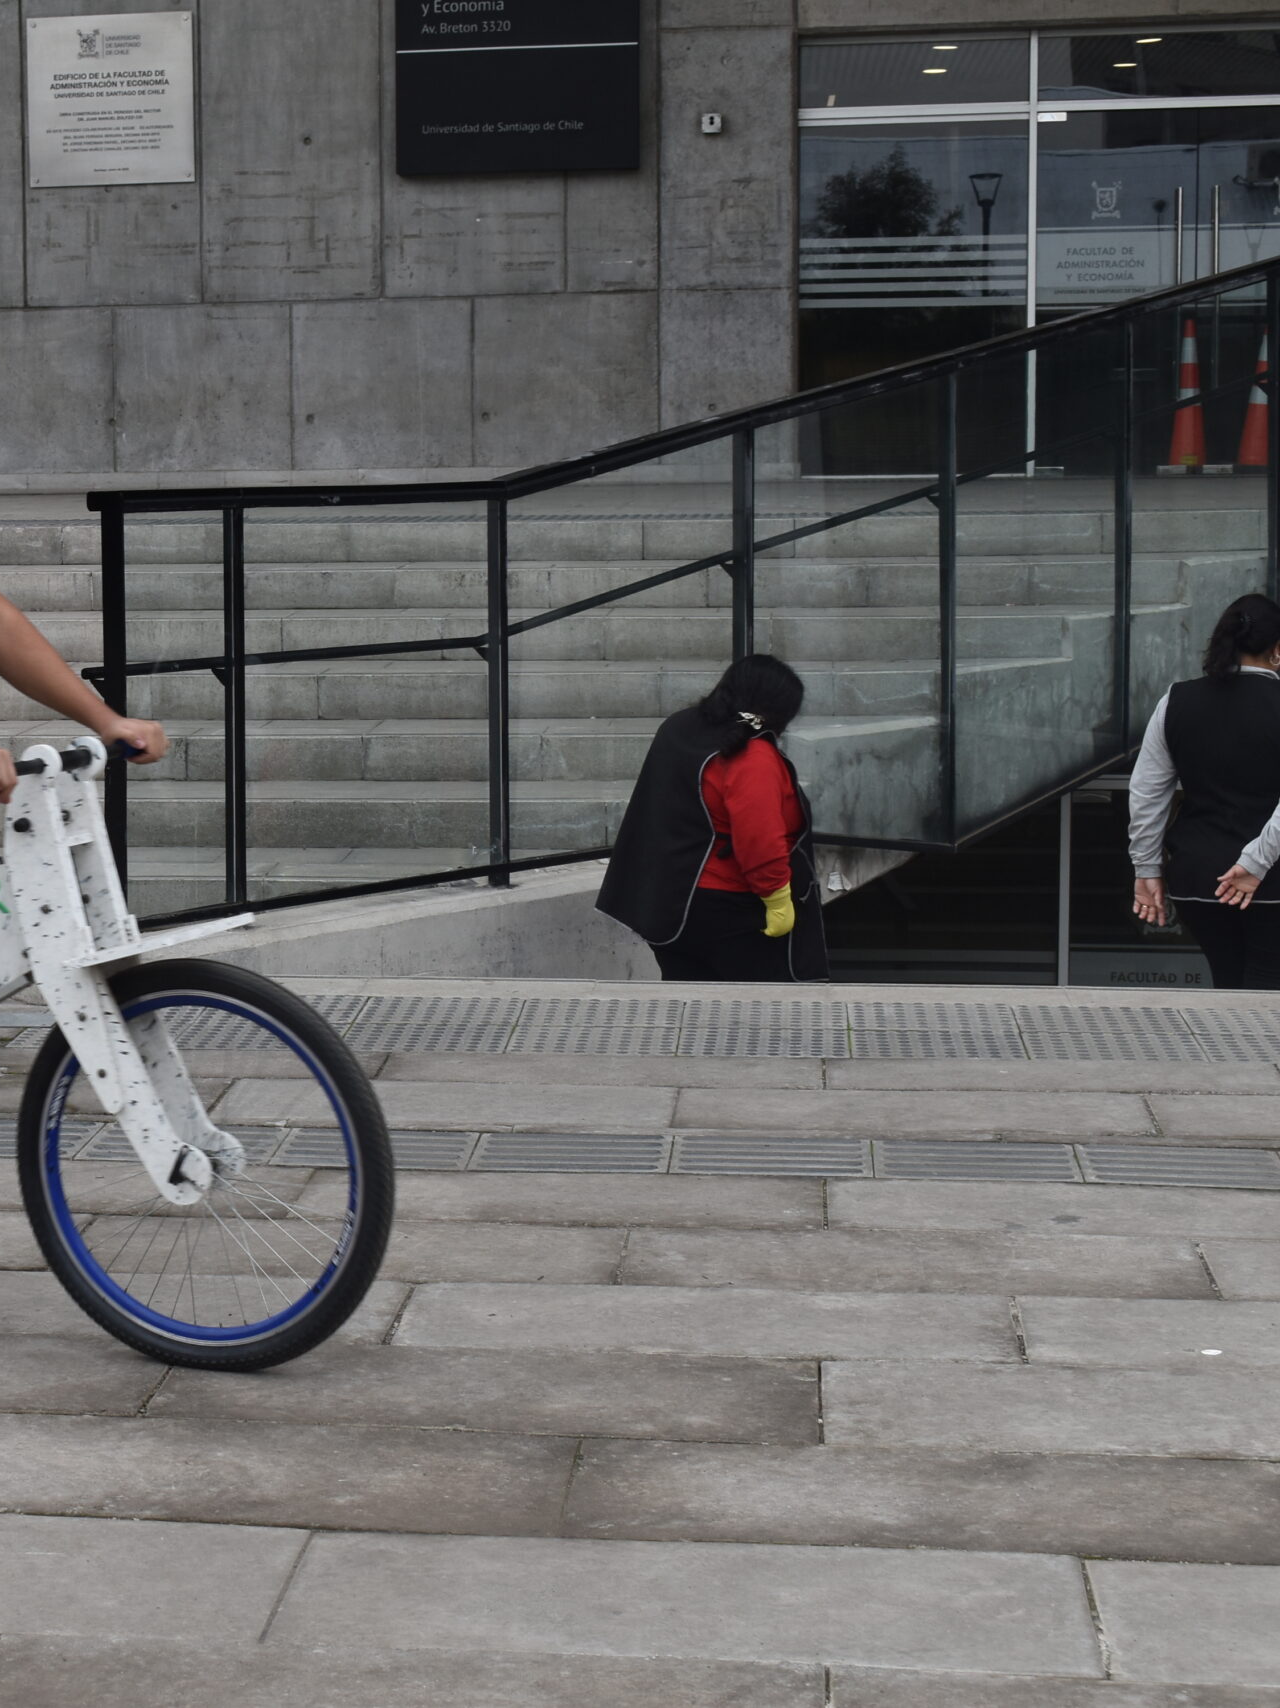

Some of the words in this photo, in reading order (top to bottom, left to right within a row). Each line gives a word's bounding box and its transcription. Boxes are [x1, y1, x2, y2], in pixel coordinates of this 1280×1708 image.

[421, 3, 429, 17] y
[421, 24, 437, 34] Av.
[440, 22, 478, 33] Breton
[482, 20, 511, 32] 3320
[53, 73, 88, 81] EDIFICIO
[88, 72, 100, 80] DE
[113, 70, 153, 79] FACULTAD
[155, 69, 166, 77] DE
[54, 91, 95, 99] UNIVERSIDAD
[421, 123, 480, 134] Universidad
[482, 122, 495, 132] de
[497, 121, 541, 133] Santiago
[543, 120, 556, 130] de
[558, 119, 585, 130] Chile
[1066, 247, 1117, 256] FACULTAD
[1121, 246, 1135, 255] DE
[1065, 273, 1073, 281] Y
[1110, 971, 1177, 984] FACULTAD
[1184, 972, 1202, 984] DE
